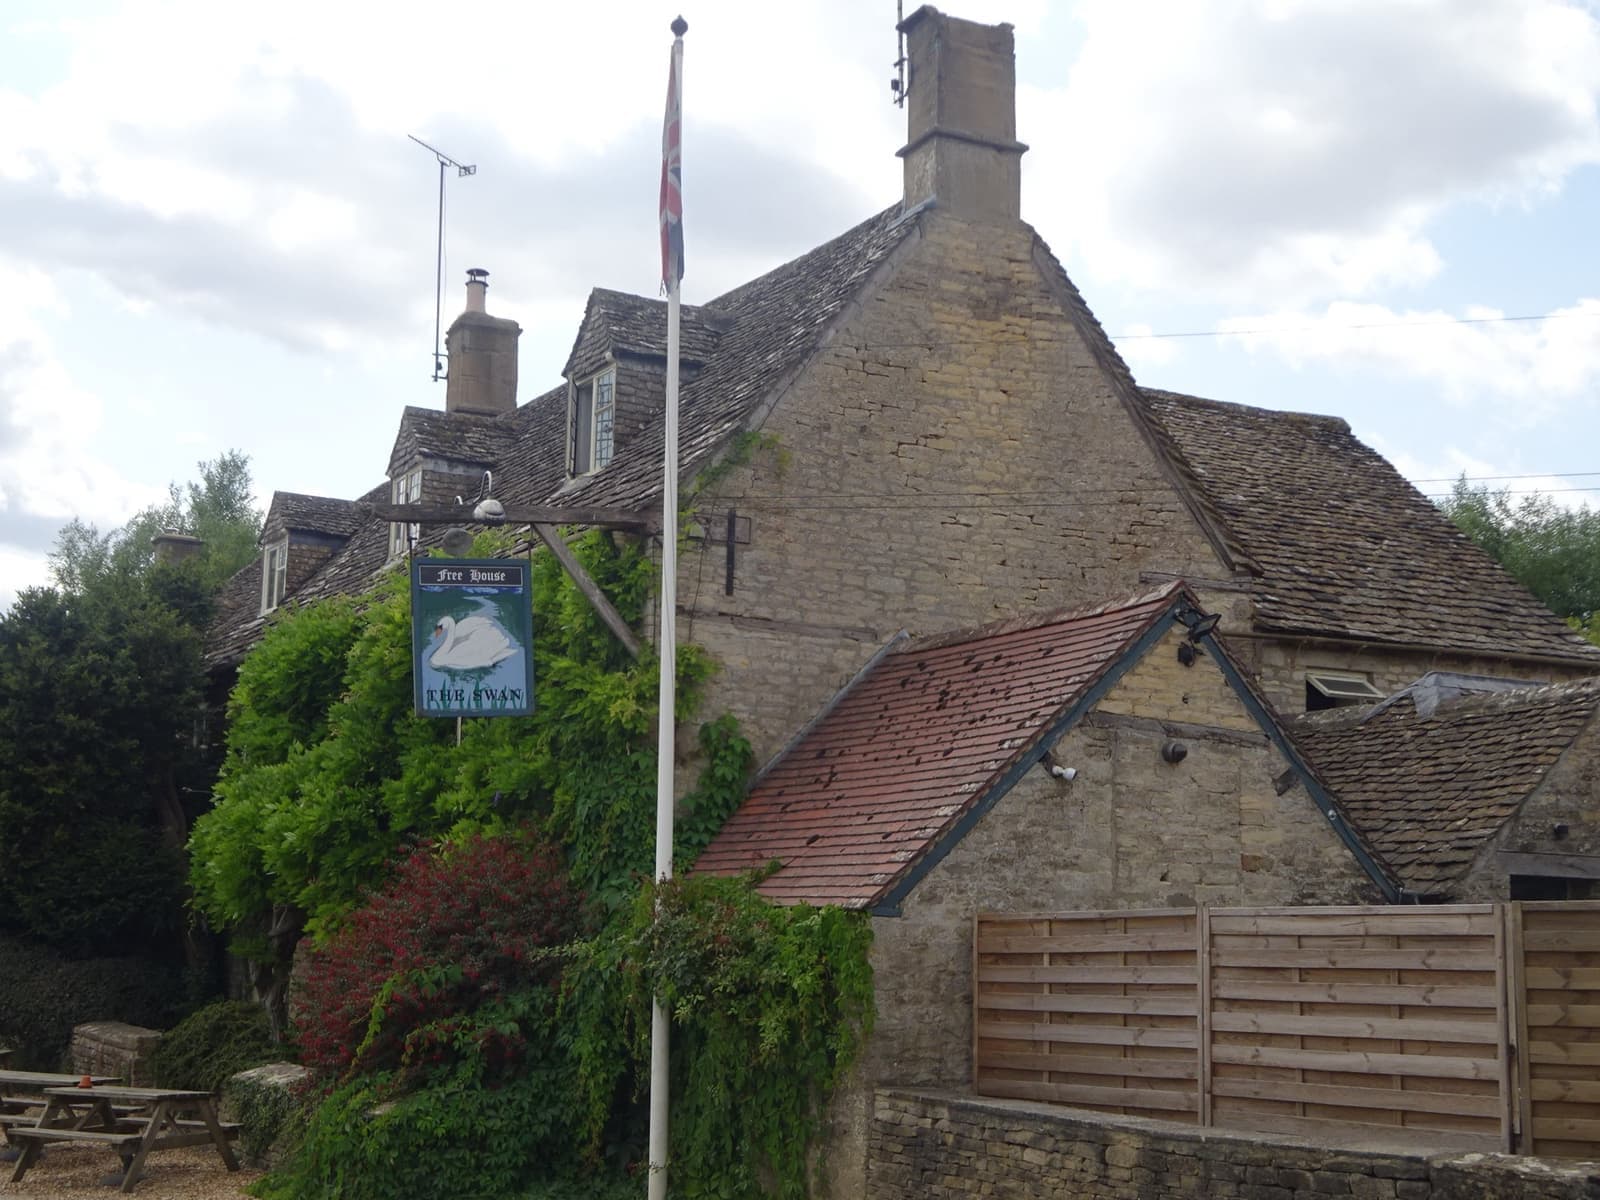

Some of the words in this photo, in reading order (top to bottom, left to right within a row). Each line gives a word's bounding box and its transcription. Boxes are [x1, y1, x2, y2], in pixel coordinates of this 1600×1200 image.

[437, 568, 463, 582] Free
[470, 569, 506, 583] House
[427, 689, 465, 701] THE
[473, 688, 522, 701] SWAN
